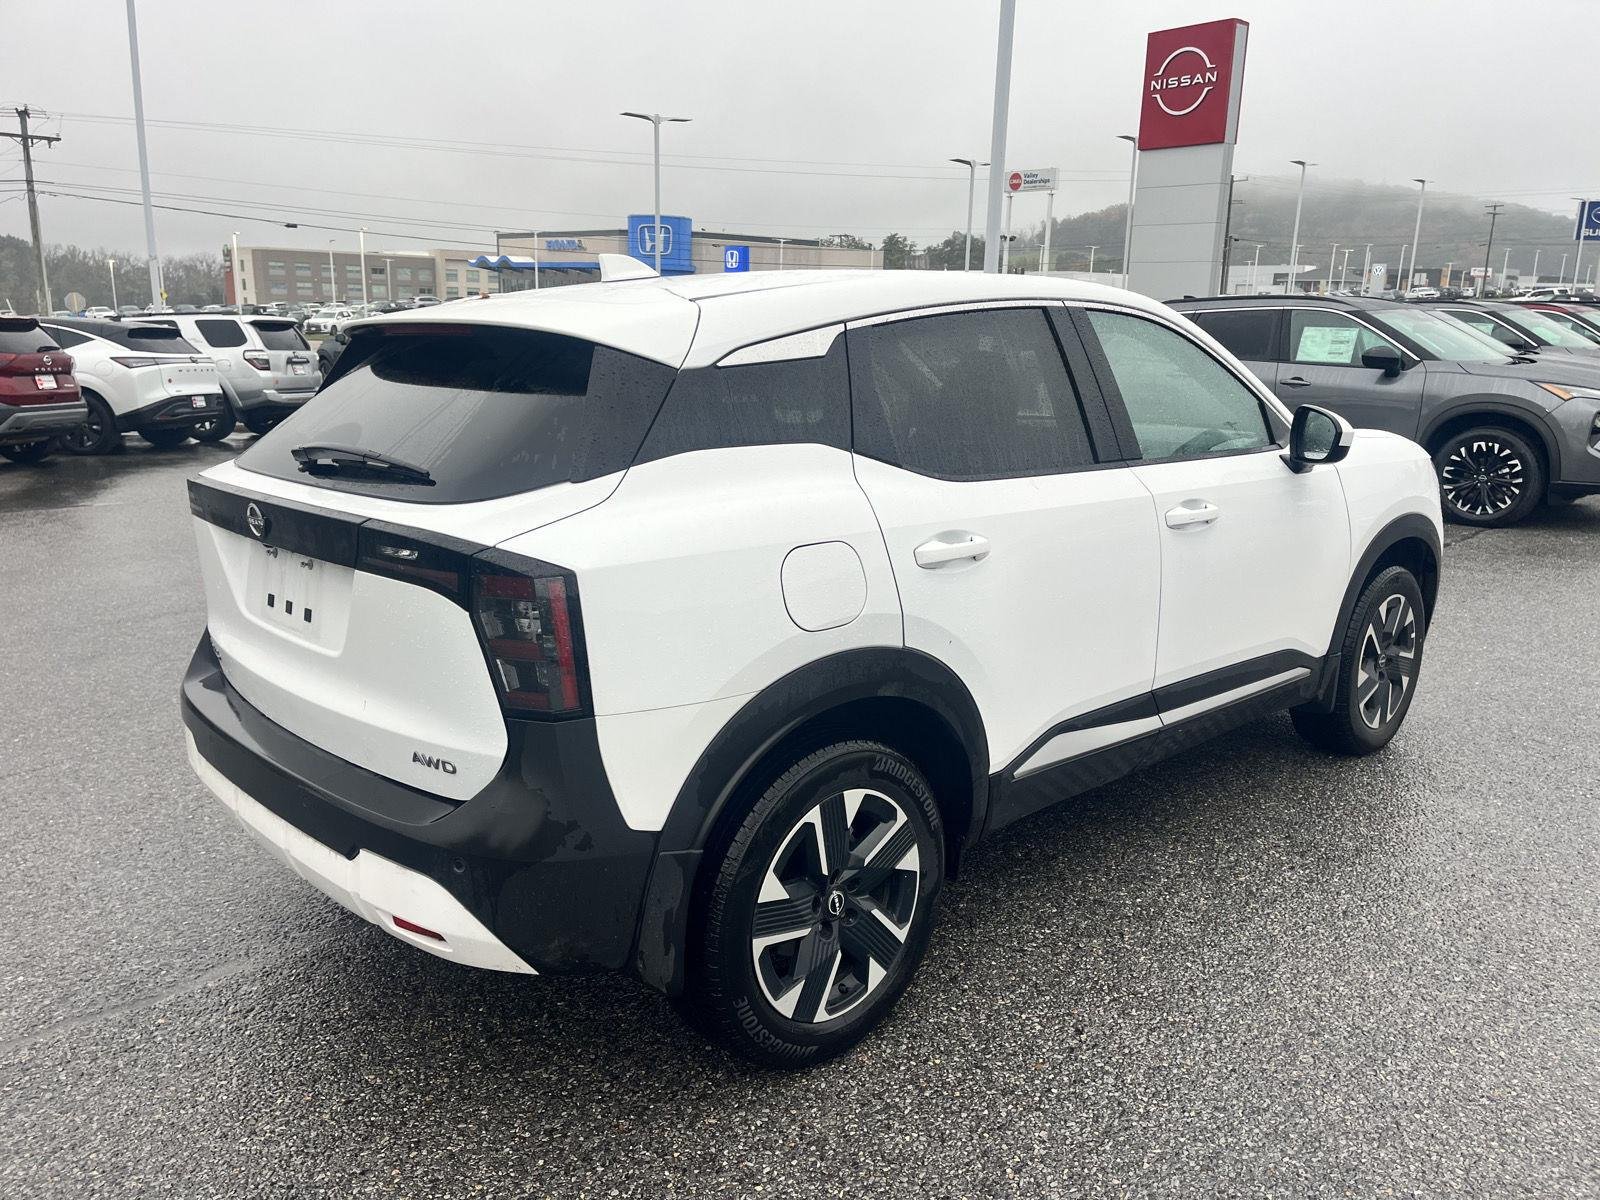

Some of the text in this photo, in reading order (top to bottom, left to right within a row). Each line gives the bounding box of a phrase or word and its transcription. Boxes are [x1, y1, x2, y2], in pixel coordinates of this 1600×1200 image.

[1150, 71, 1217, 91] NISSAN
[412, 751, 457, 775] AWD
[872, 754, 940, 831] BRIDGESTONE
